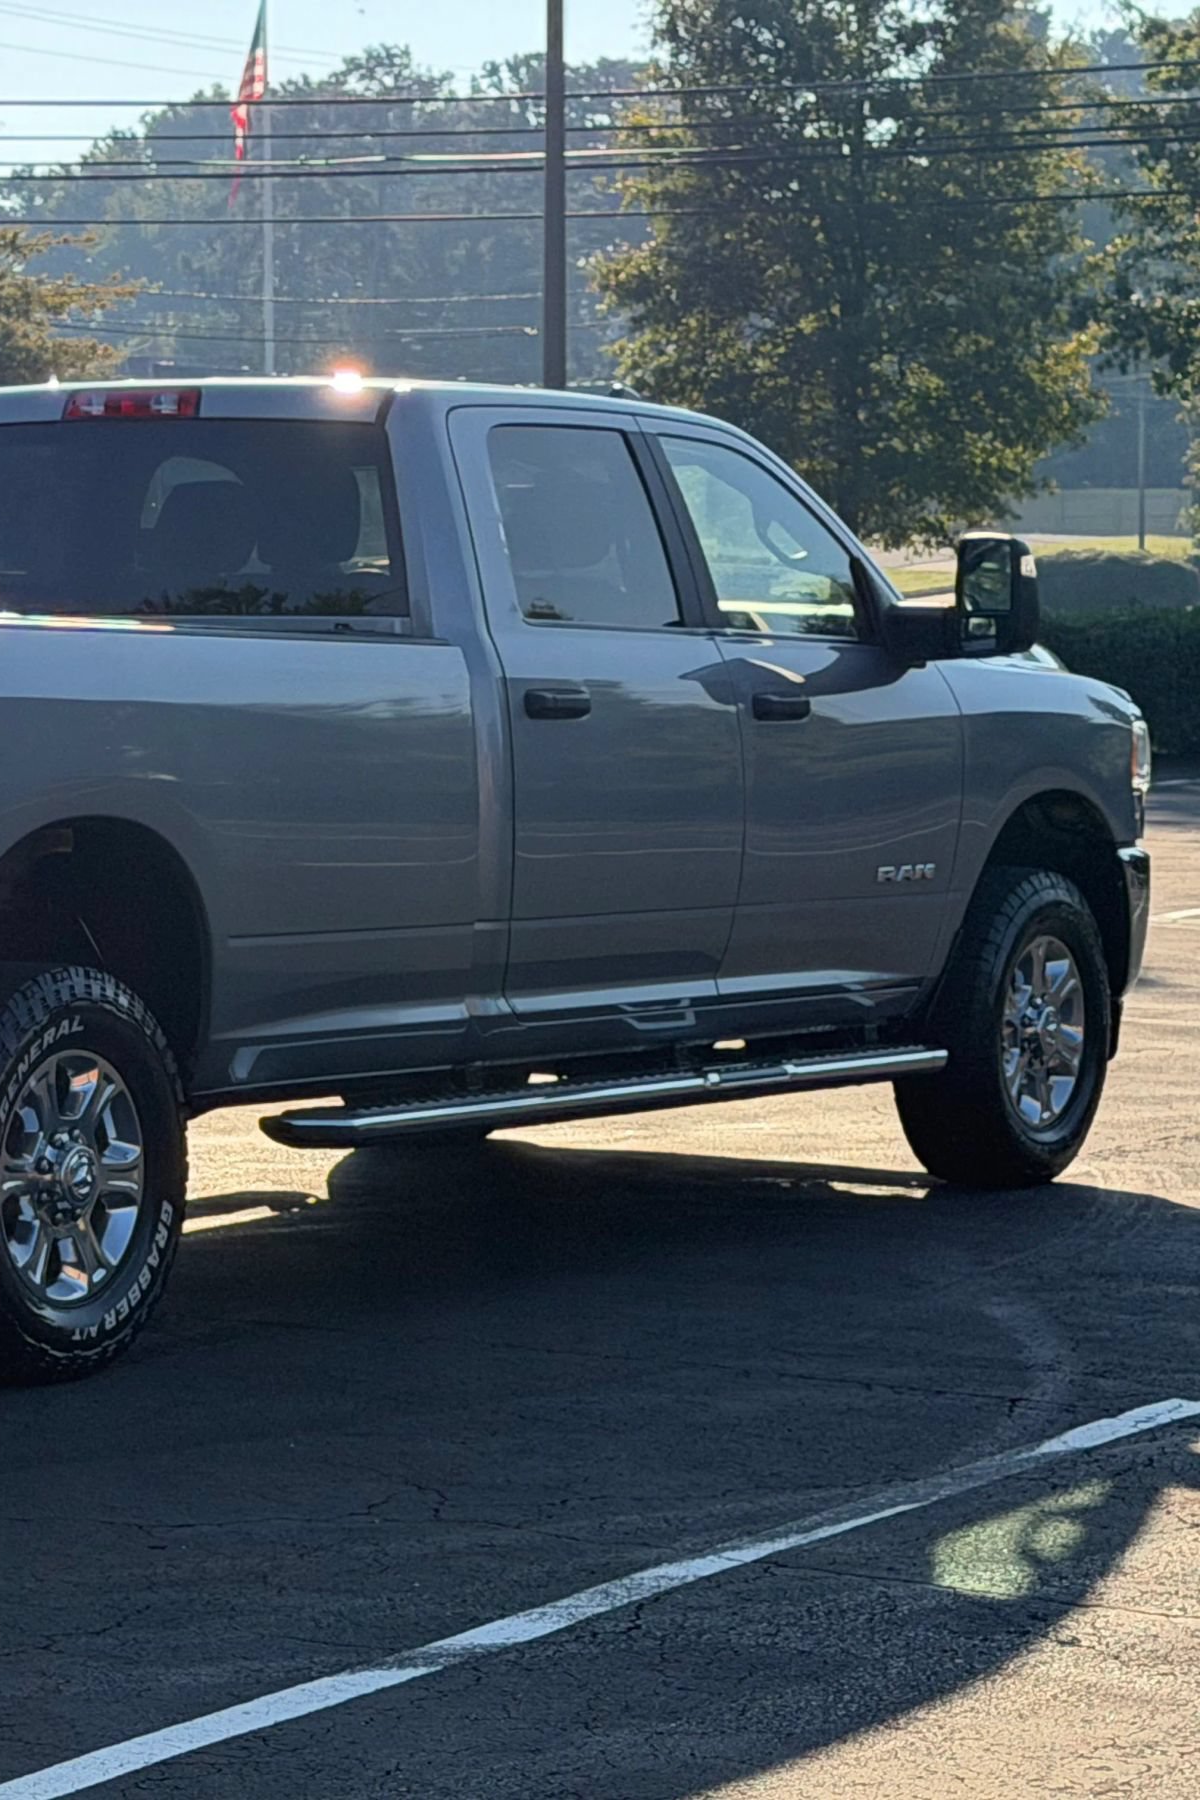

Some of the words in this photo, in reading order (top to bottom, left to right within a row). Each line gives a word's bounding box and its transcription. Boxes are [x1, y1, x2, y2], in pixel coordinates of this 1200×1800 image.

[877, 863, 936, 881] RAM
[0, 1015, 85, 1122] GENERAL
[103, 1200, 174, 1321] GRABBER
